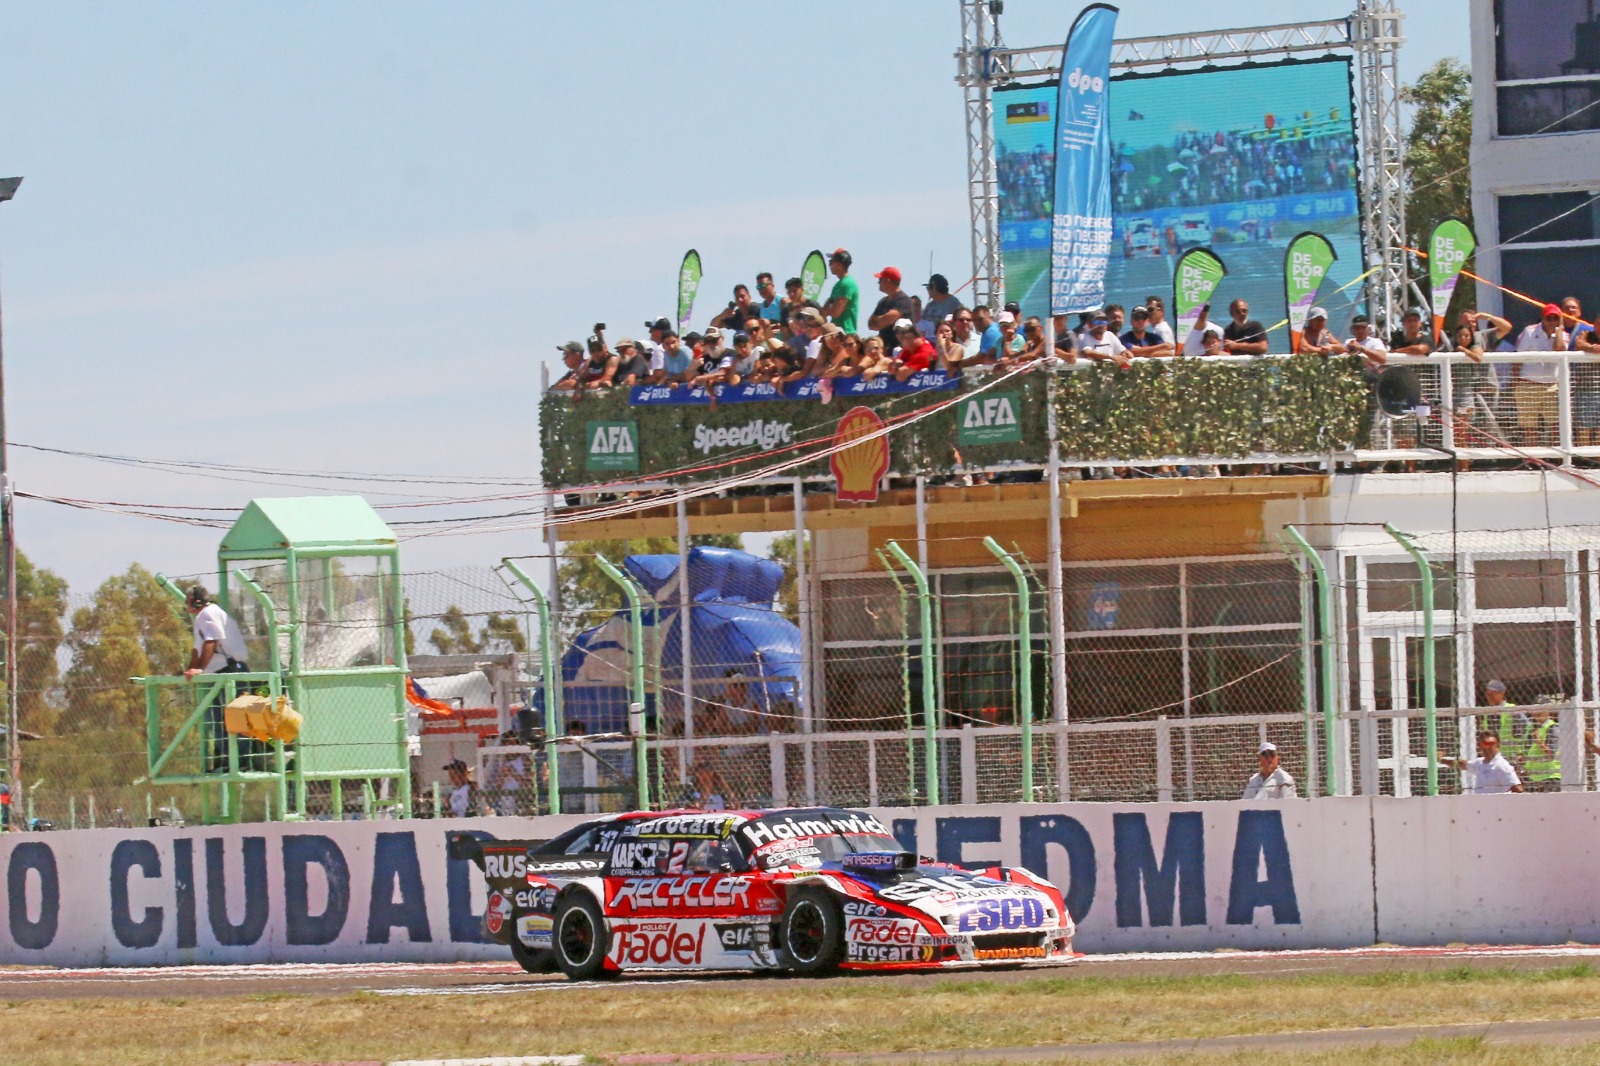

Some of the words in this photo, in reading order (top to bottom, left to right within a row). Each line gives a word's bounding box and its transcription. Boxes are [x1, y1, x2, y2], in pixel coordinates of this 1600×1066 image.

[1068, 67, 1103, 95] dpa
[1436, 236, 1454, 249] DE
[1293, 252, 1311, 265] DE
[1436, 248, 1464, 261] POR
[1183, 266, 1202, 279] DE
[1293, 264, 1323, 276] POR
[1435, 261, 1452, 273] TE
[1182, 279, 1213, 291] POR
[1293, 277, 1310, 289] TE
[1182, 289, 1199, 302] TE
[866, 377, 887, 390] RUS
[923, 374, 944, 386] RUS
[651, 388, 671, 399] RUS
[756, 383, 776, 395] RUS
[964, 398, 1017, 427] AFA
[590, 427, 634, 453] AFA
[743, 814, 894, 847] Haimovich
[666, 842, 690, 874] 2
[484, 855, 526, 878] RUS
[7, 842, 60, 949] O
[515, 889, 541, 908] elf
[956, 898, 1044, 932] ESCO
[721, 927, 752, 945] elf
[849, 918, 920, 944] Fadel
[612, 922, 706, 965] Fadel
[933, 936, 968, 946] INTEGRA
[849, 942, 920, 961] Brocart
